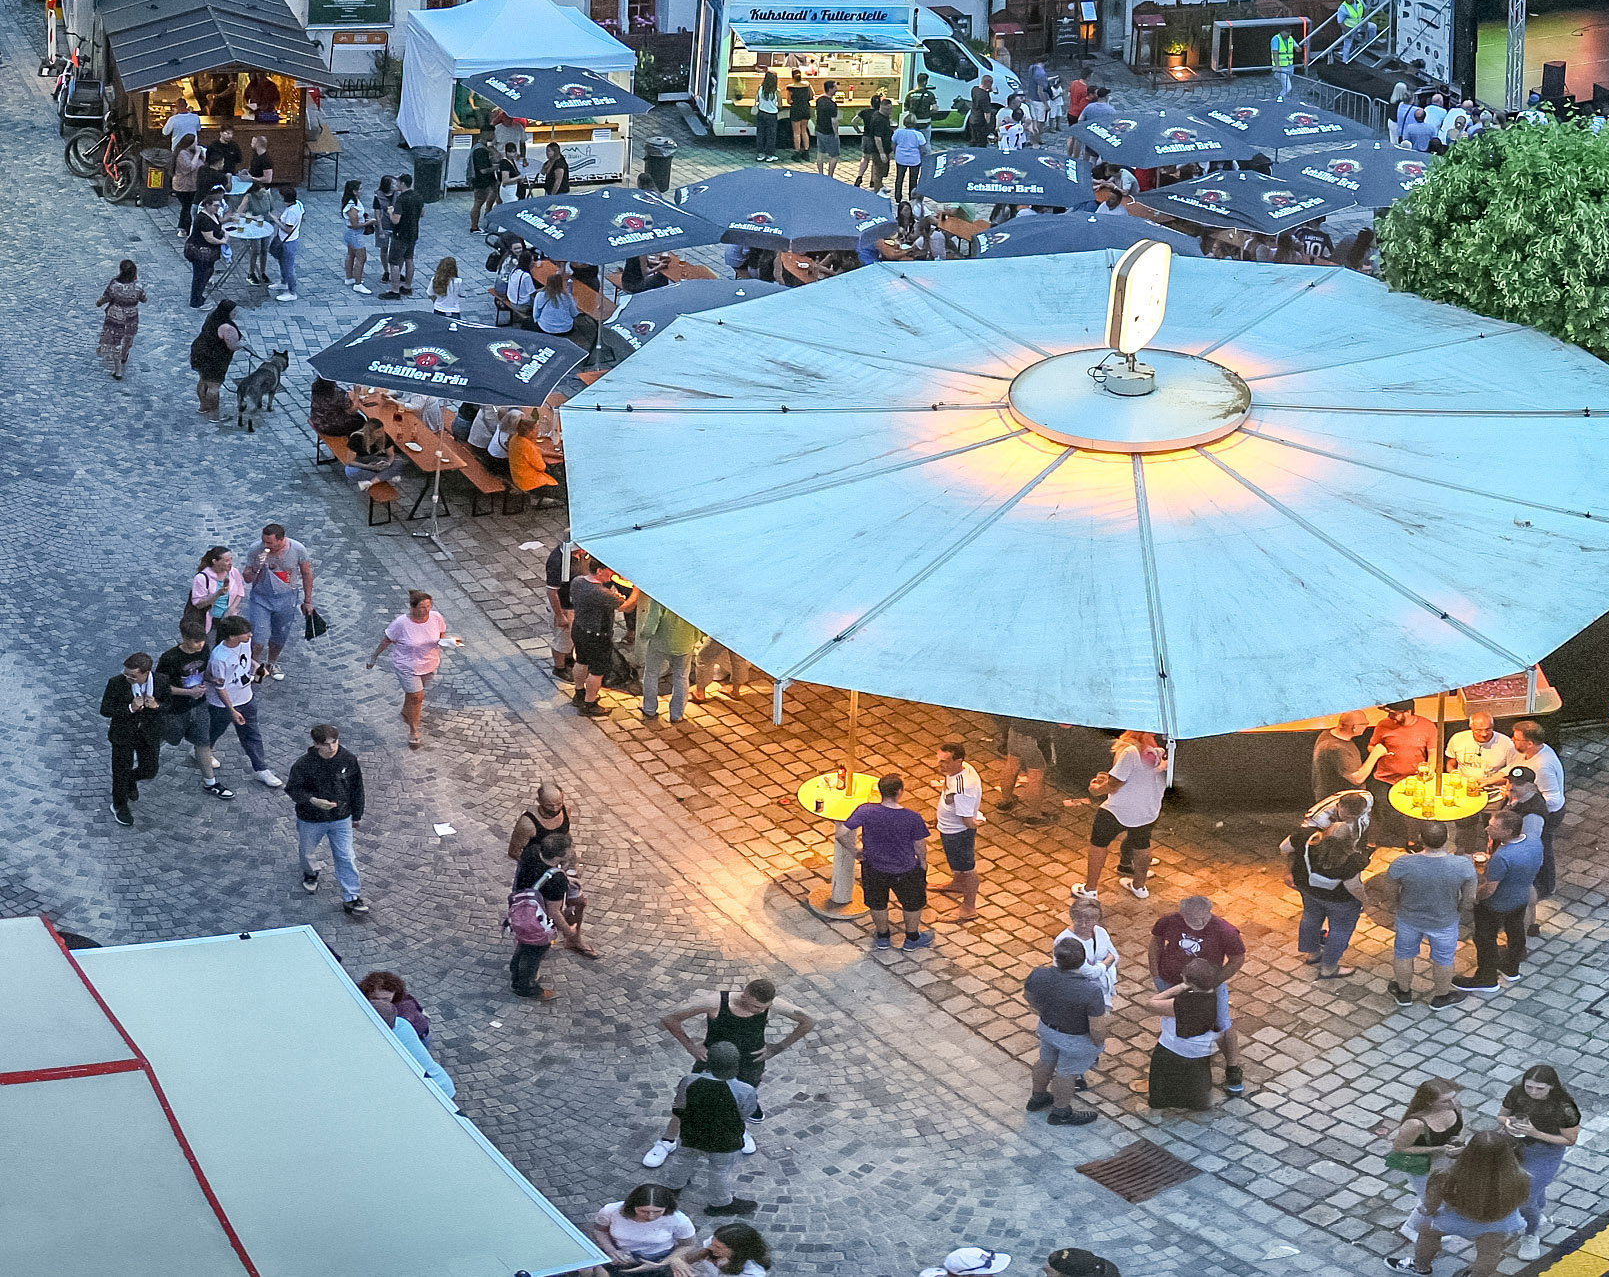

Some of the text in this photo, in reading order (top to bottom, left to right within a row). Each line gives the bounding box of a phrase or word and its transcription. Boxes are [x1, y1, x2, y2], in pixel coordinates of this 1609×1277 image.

[749, 8, 888, 22] Kuhstadl's Futterstelle
[1154, 139, 1222, 155] Schäffler Bräu
[966, 182, 1044, 194] Schäffler Bräu
[607, 225, 683, 247] Schäffler Bräu
[1305, 241, 1322, 257] 10
[368, 360, 470, 387] Schäffler Bräu
